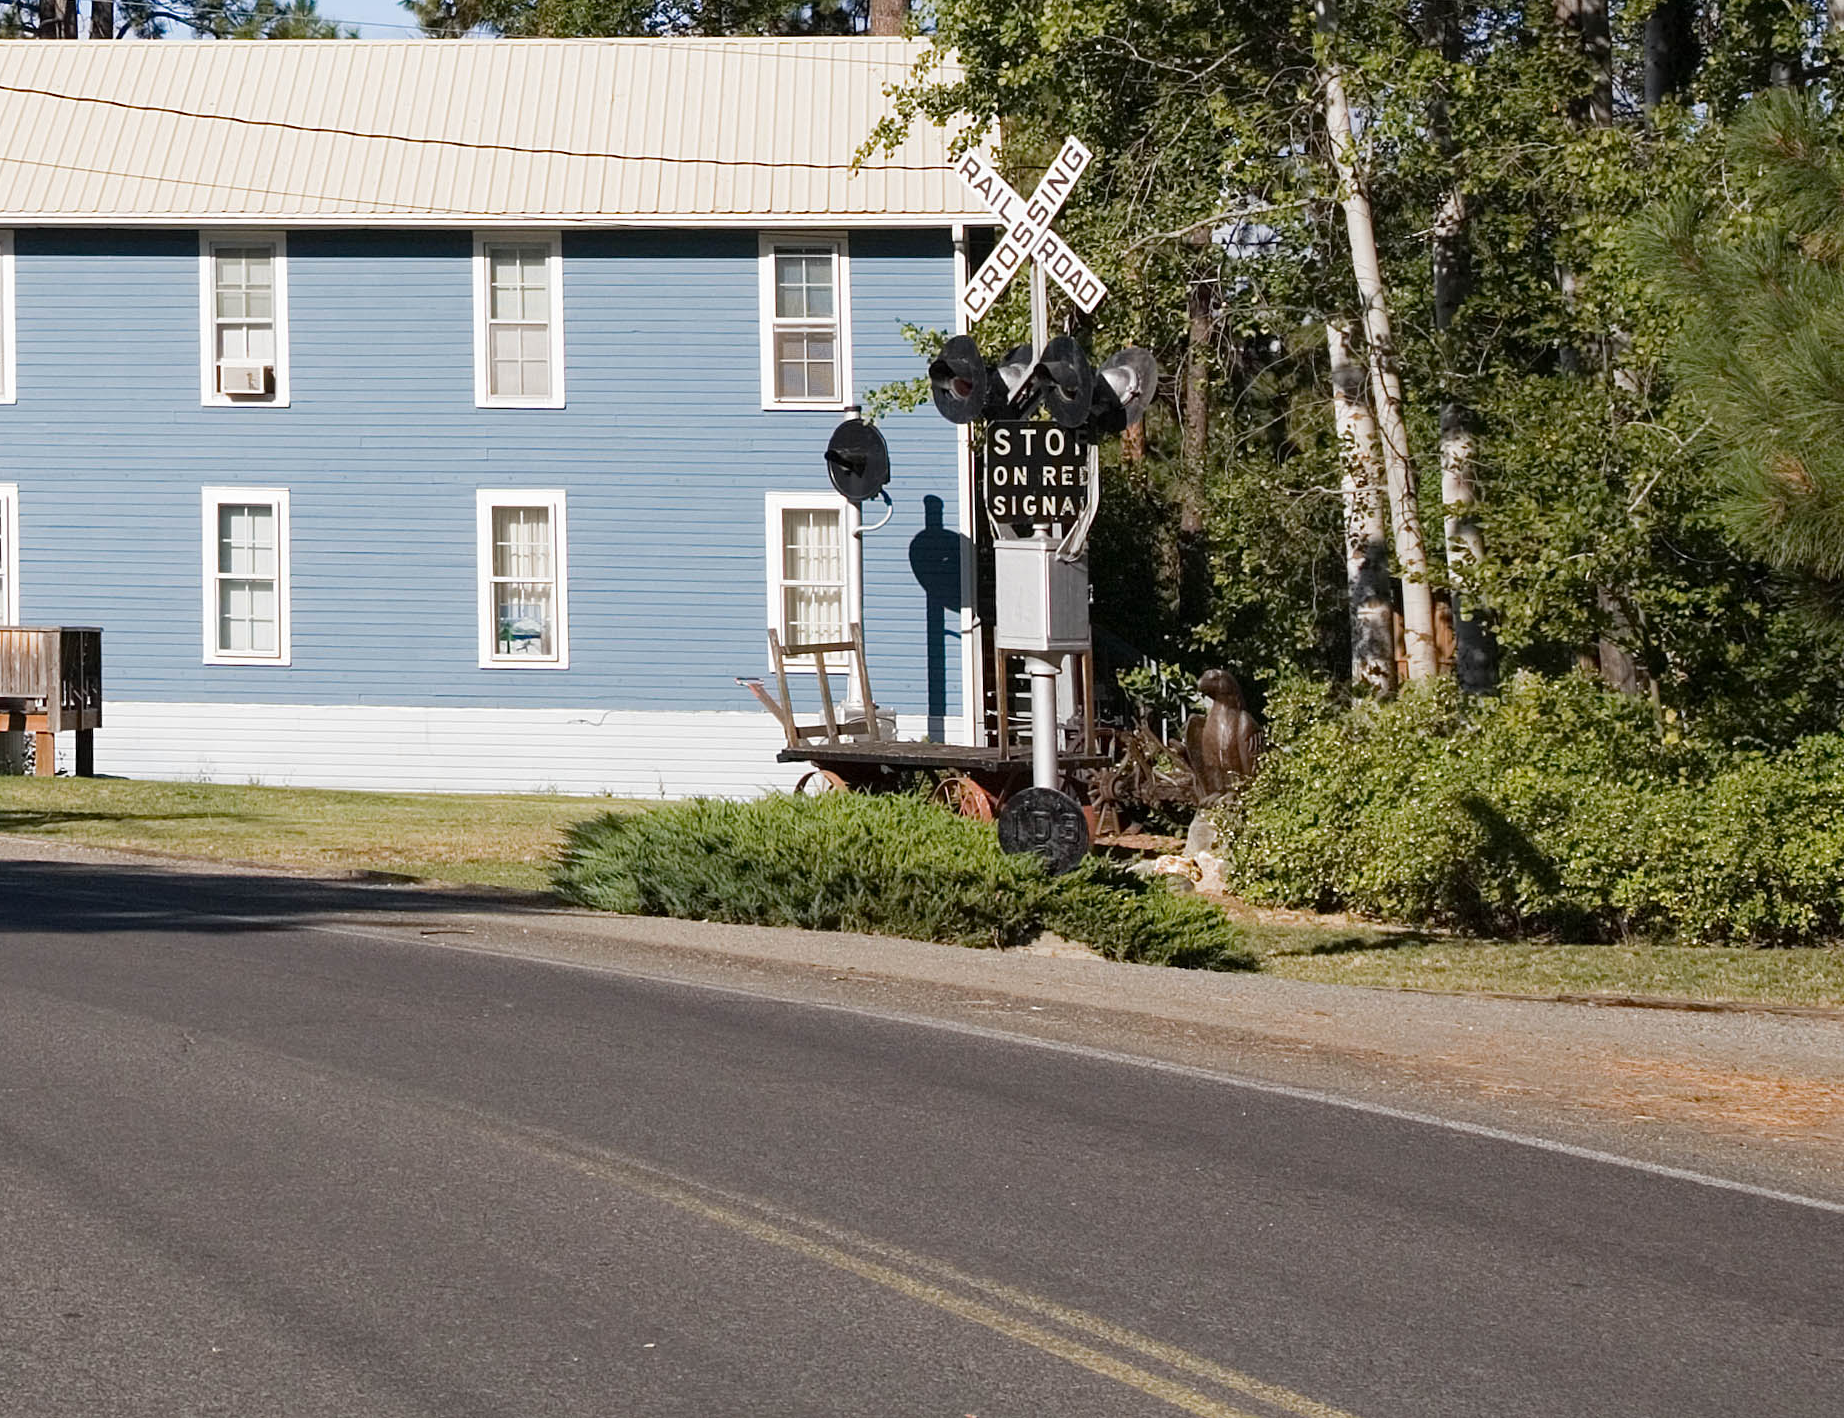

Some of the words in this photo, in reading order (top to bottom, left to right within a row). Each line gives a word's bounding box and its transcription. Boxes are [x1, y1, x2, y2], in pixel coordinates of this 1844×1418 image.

[959, 156, 1012, 224] RAIL
[1037, 236, 1099, 305] ROAD
[963, 145, 1084, 314] CROSSING
[993, 465, 1028, 486] ON
